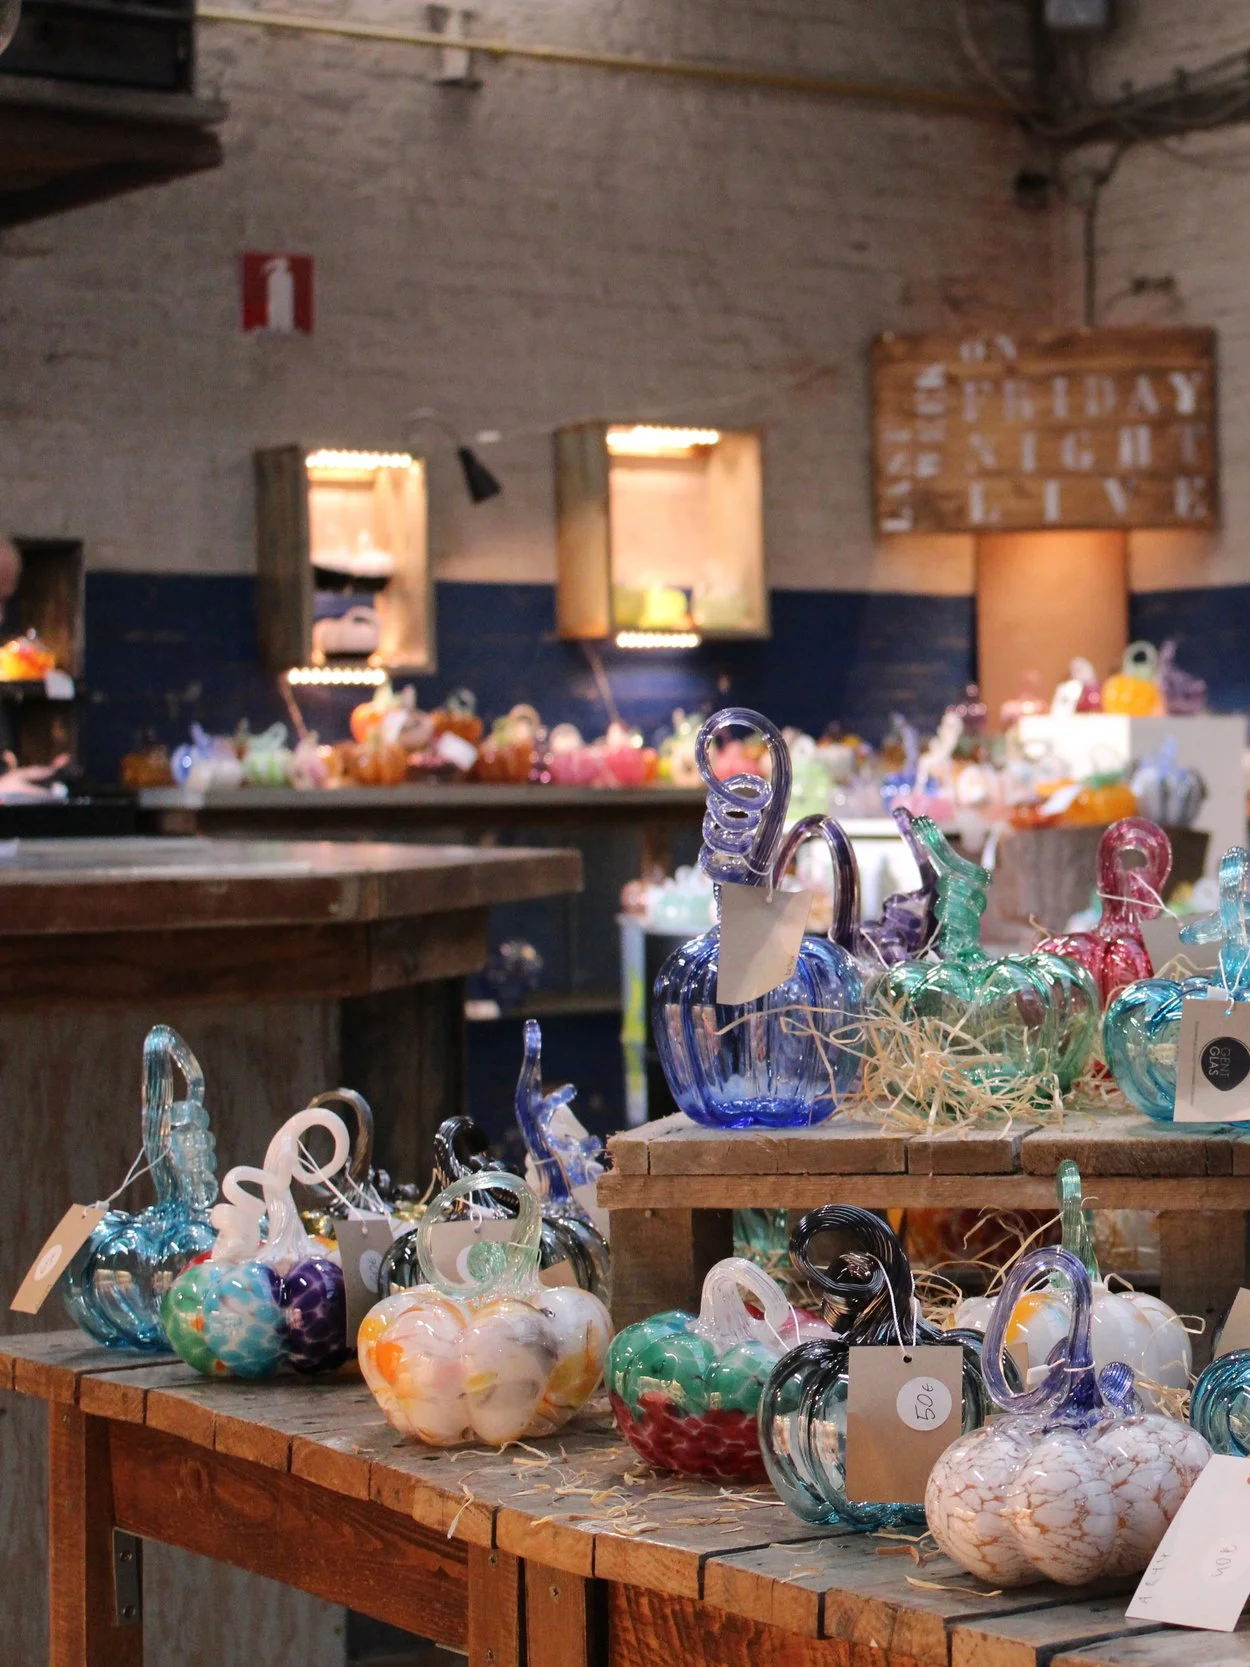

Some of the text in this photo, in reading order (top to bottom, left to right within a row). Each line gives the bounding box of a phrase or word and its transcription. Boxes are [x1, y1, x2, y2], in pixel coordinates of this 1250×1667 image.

[959, 333, 1018, 364] ON
[961, 370, 1204, 423] FRIDAY
[968, 421, 1207, 474] NIGHT
[968, 475, 1207, 526] LIVE
[1208, 1046, 1220, 1076] GLAS
[1220, 1047, 1231, 1078] GENT
[915, 1383, 936, 1421] 50€
